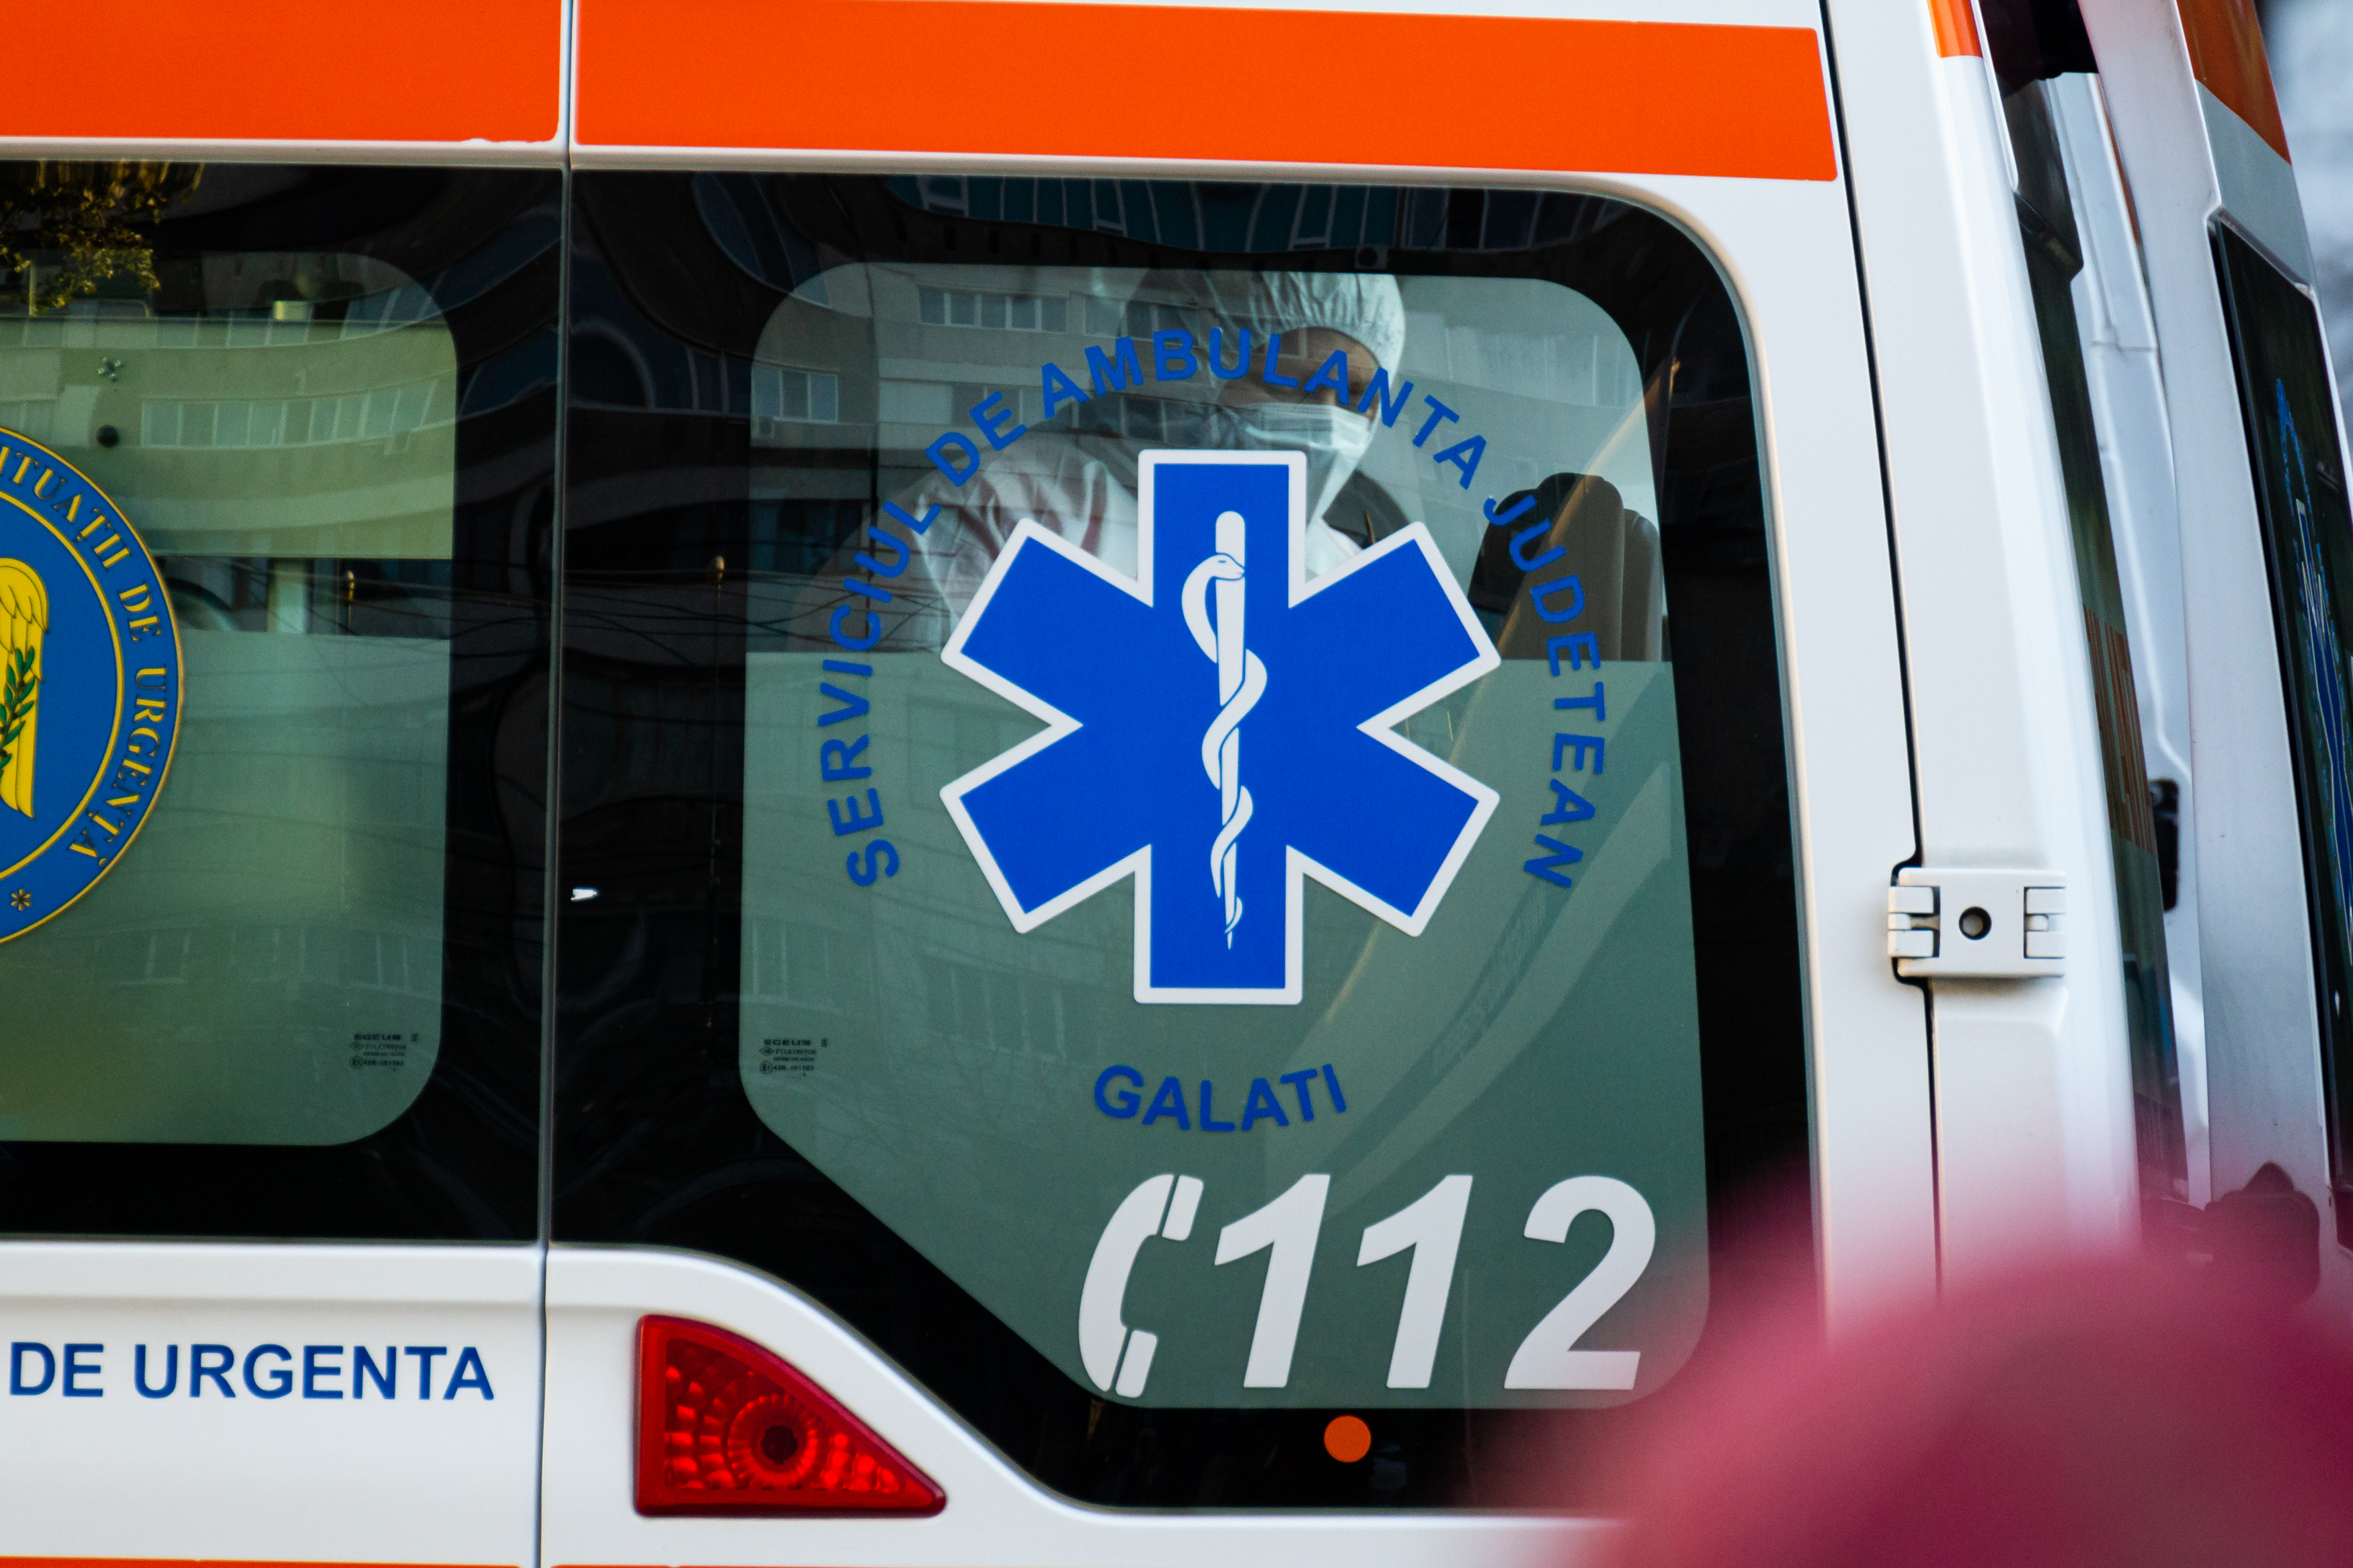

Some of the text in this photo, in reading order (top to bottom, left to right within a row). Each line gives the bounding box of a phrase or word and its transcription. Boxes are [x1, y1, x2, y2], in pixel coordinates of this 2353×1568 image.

[117, 581, 162, 643] DE
[817, 327, 1606, 889] SERVICIUL DE AMBULANTA JUDETEAN
[1093, 1064, 1347, 1133] GALATI
[1213, 1173, 1657, 1391] 112
[9, 1342, 495, 1401] DE URGENTA
